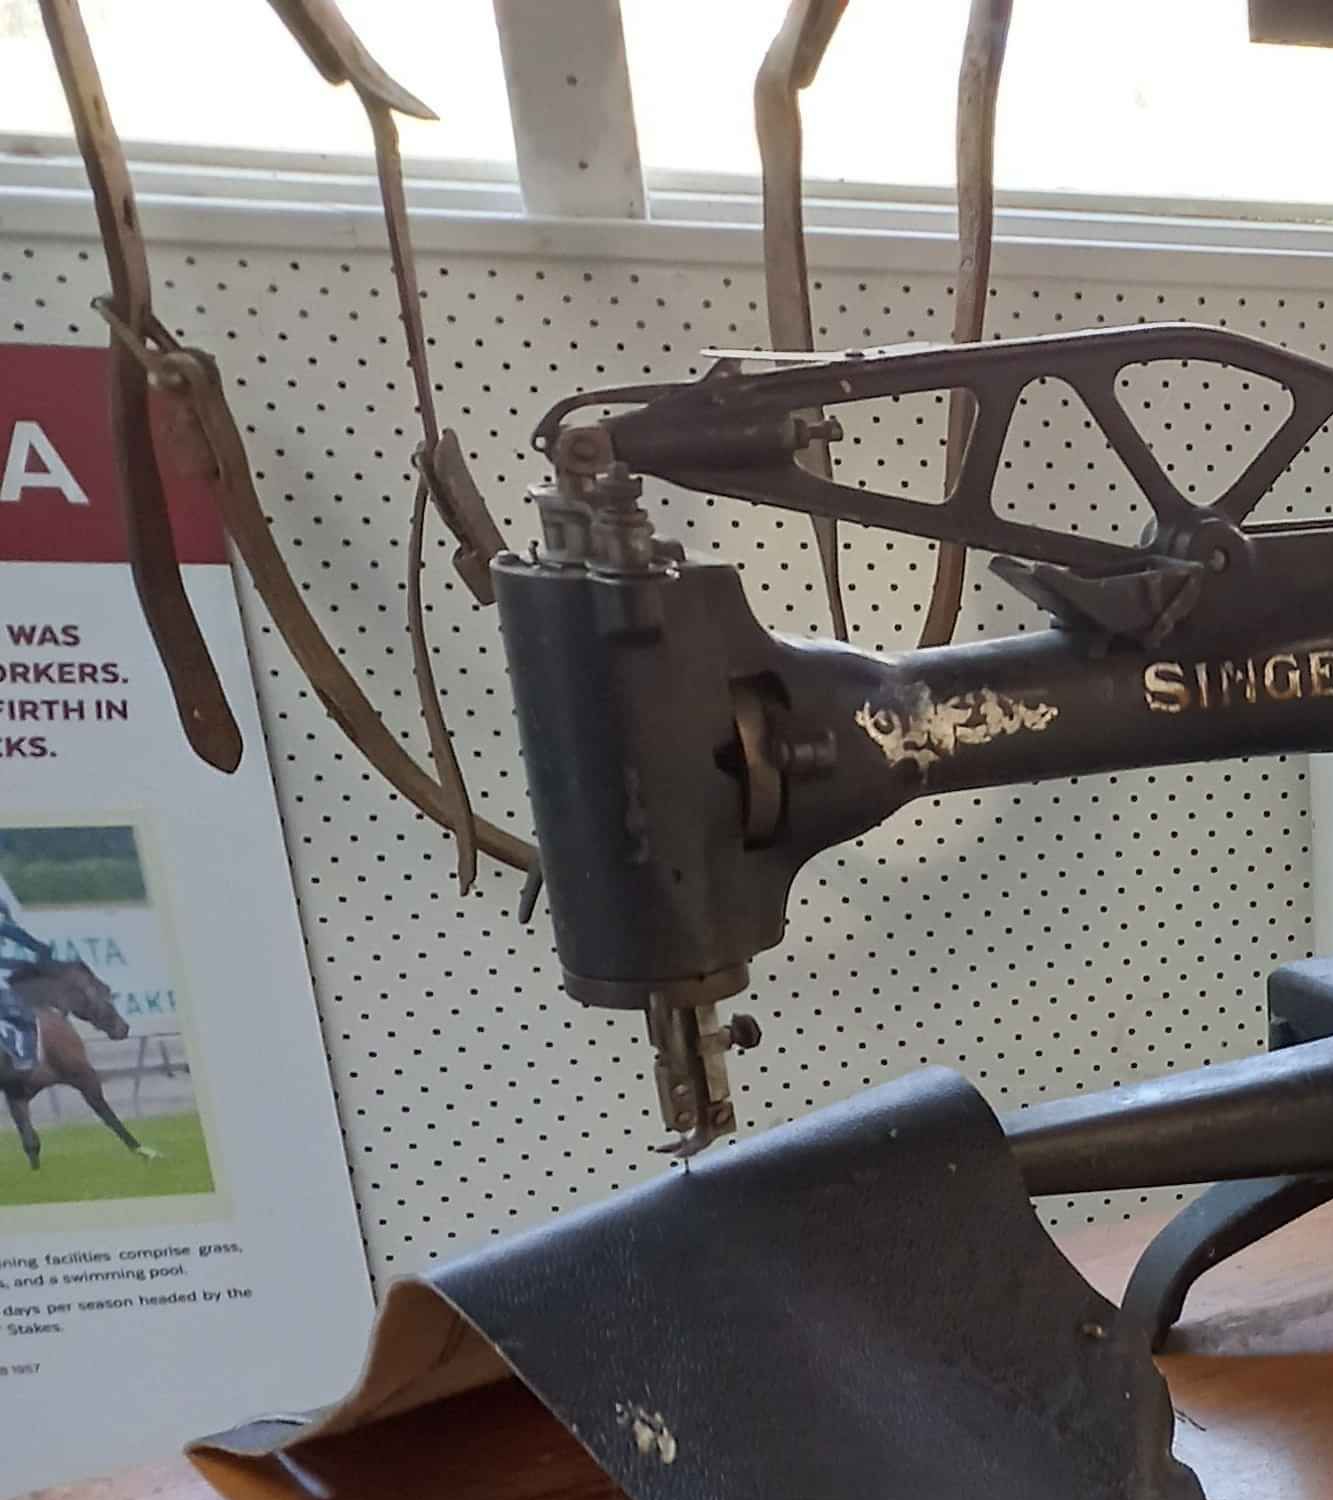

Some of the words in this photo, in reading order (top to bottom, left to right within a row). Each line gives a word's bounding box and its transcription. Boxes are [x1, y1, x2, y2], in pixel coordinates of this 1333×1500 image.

[1, 420, 90, 504] A
[6, 623, 81, 647] WAS
[95, 699, 128, 721] IN
[0, 736, 57, 758] KS.
[44, 1251, 112, 1266] facilities
[119, 1245, 191, 1261] comprise
[198, 1243, 243, 1258] grass,
[14, 1274, 44, 1287] and
[49, 1276, 59, 1285] a
[63, 1268, 146, 1284] swimming
[3, 1304, 41, 1317] days
[47, 1302, 71, 1315] per
[78, 1298, 134, 1311] season
[138, 1290, 197, 1306] headed
[202, 1289, 221, 1303] by
[226, 1287, 253, 1300] the
